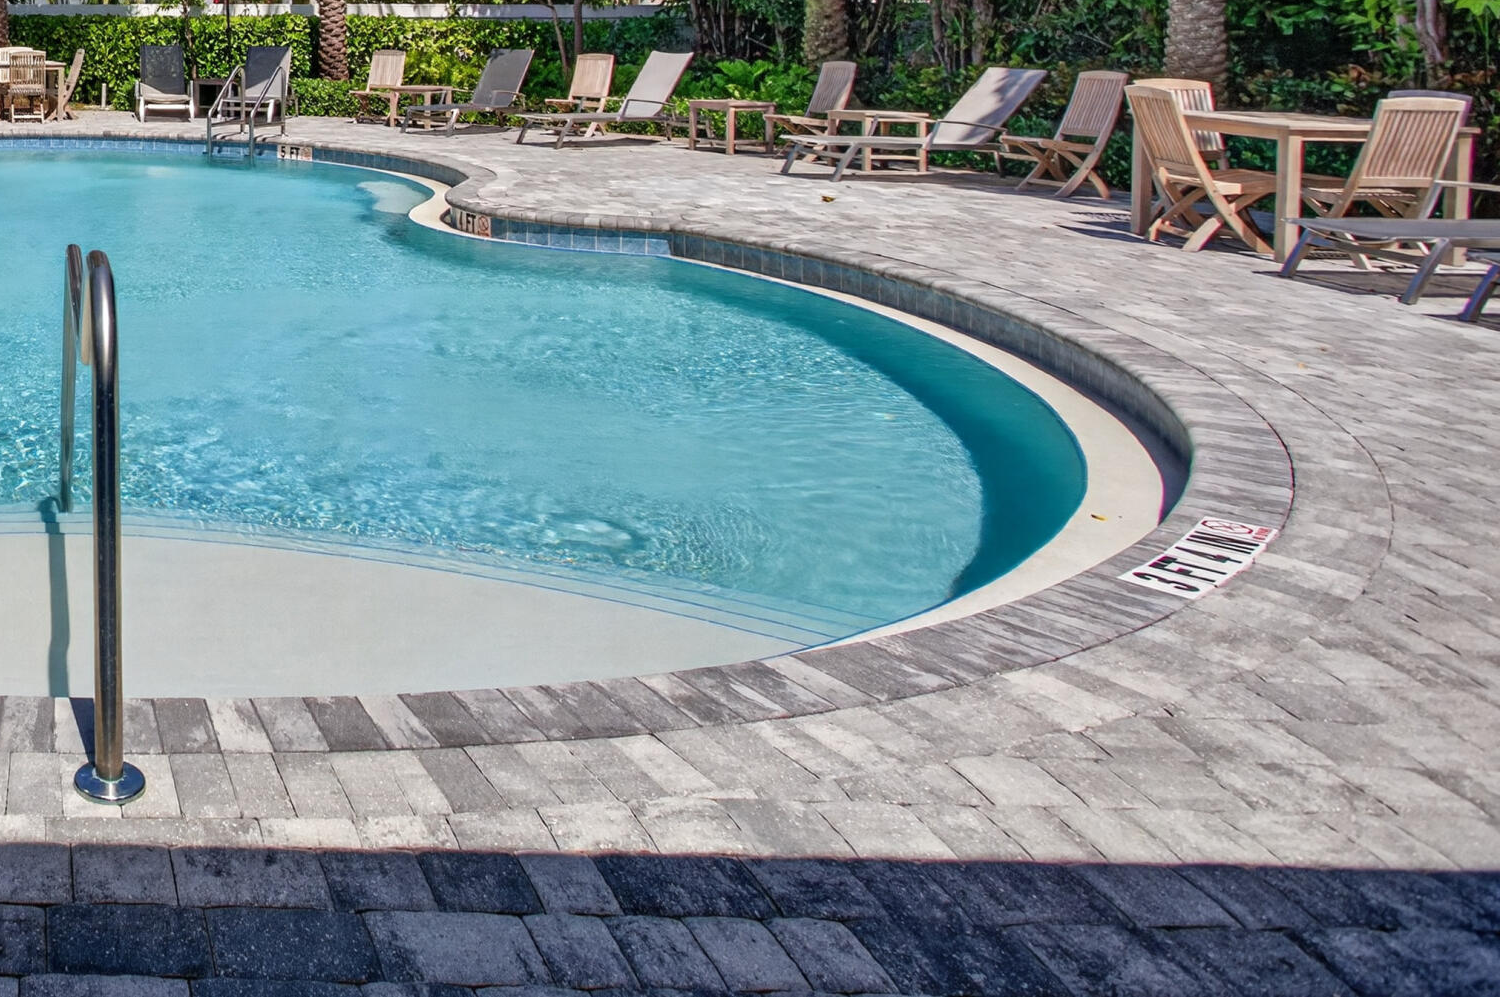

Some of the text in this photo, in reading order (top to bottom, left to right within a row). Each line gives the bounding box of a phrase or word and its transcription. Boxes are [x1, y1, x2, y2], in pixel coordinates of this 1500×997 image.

[281, 146, 300, 160] 5 FT
[466, 212, 476, 234] FT
[1186, 530, 1260, 554] IN
[1174, 546, 1243, 564] 4
[1148, 555, 1227, 583] FT
[1132, 572, 1200, 592] 3
